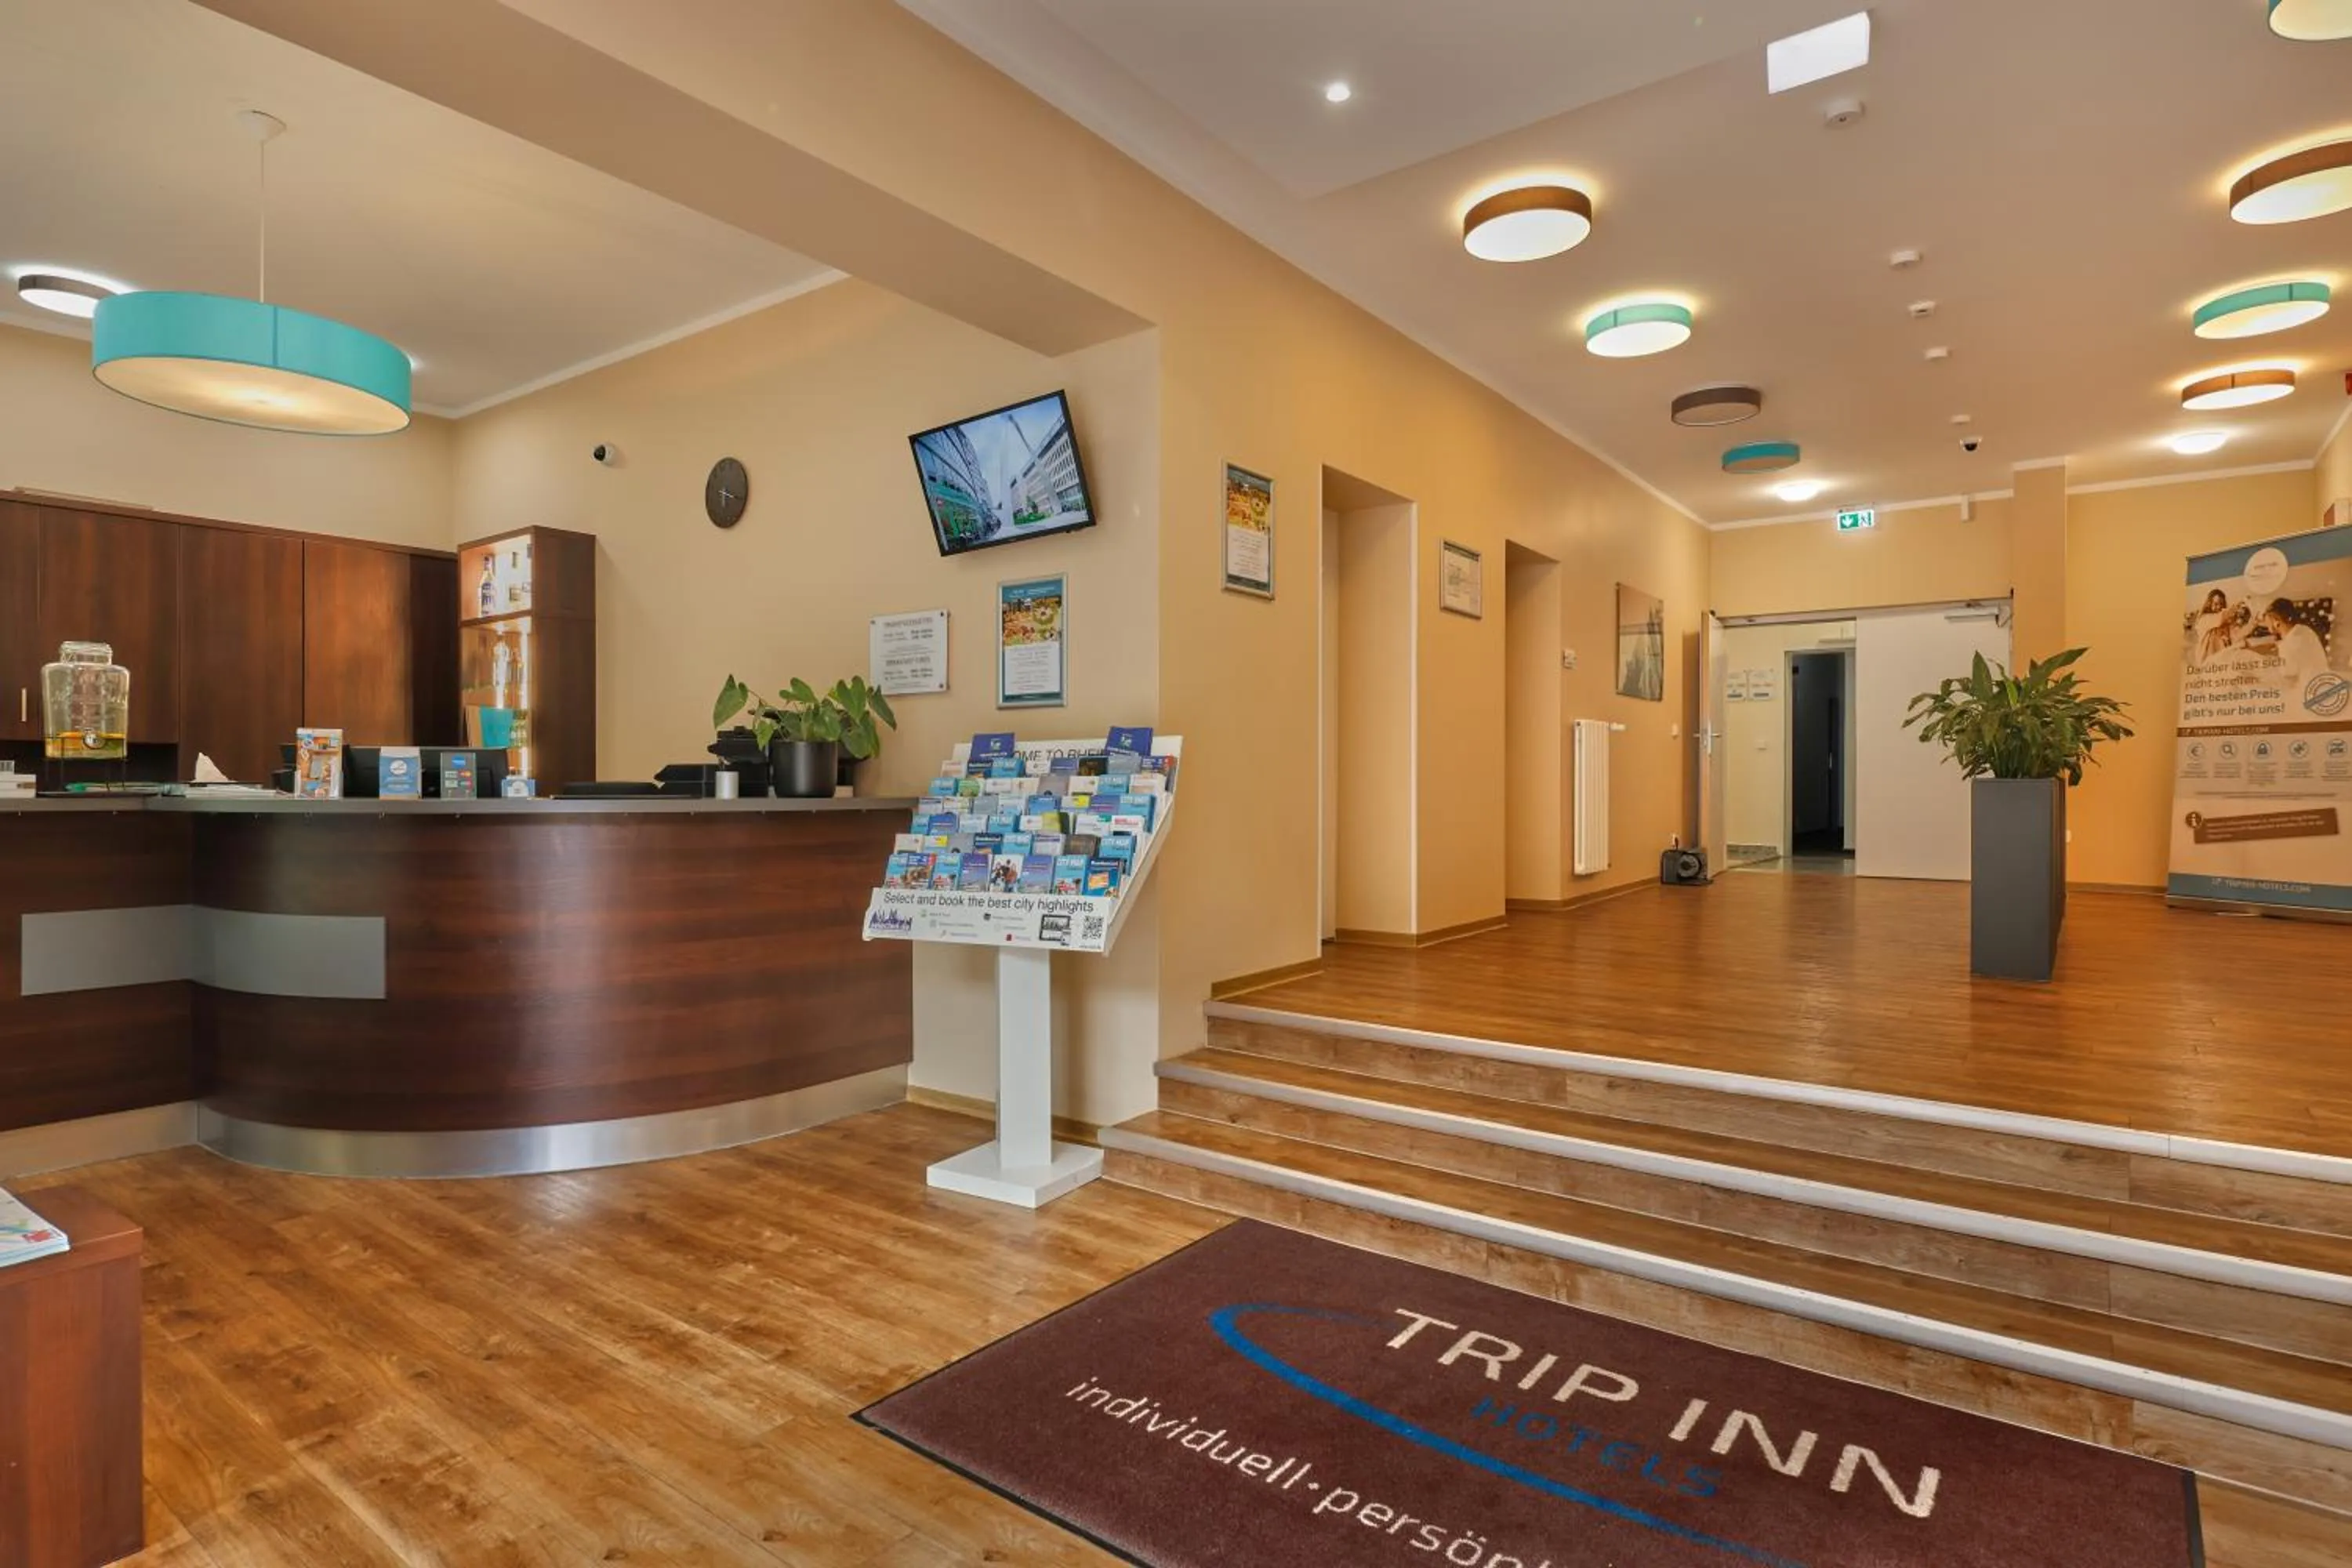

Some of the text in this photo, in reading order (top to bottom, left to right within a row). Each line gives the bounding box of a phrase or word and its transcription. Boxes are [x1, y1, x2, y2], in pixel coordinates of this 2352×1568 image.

[2185, 688, 2281, 704] Den besten Preis
[2216, 707, 2235, 717] nur
[2238, 704, 2256, 715] bei
[884, 891, 1094, 915] Select and book the best city highlights
[1385, 1308, 1943, 1519] TRIP INN
[1470, 1396, 1722, 1497] HOTELS
